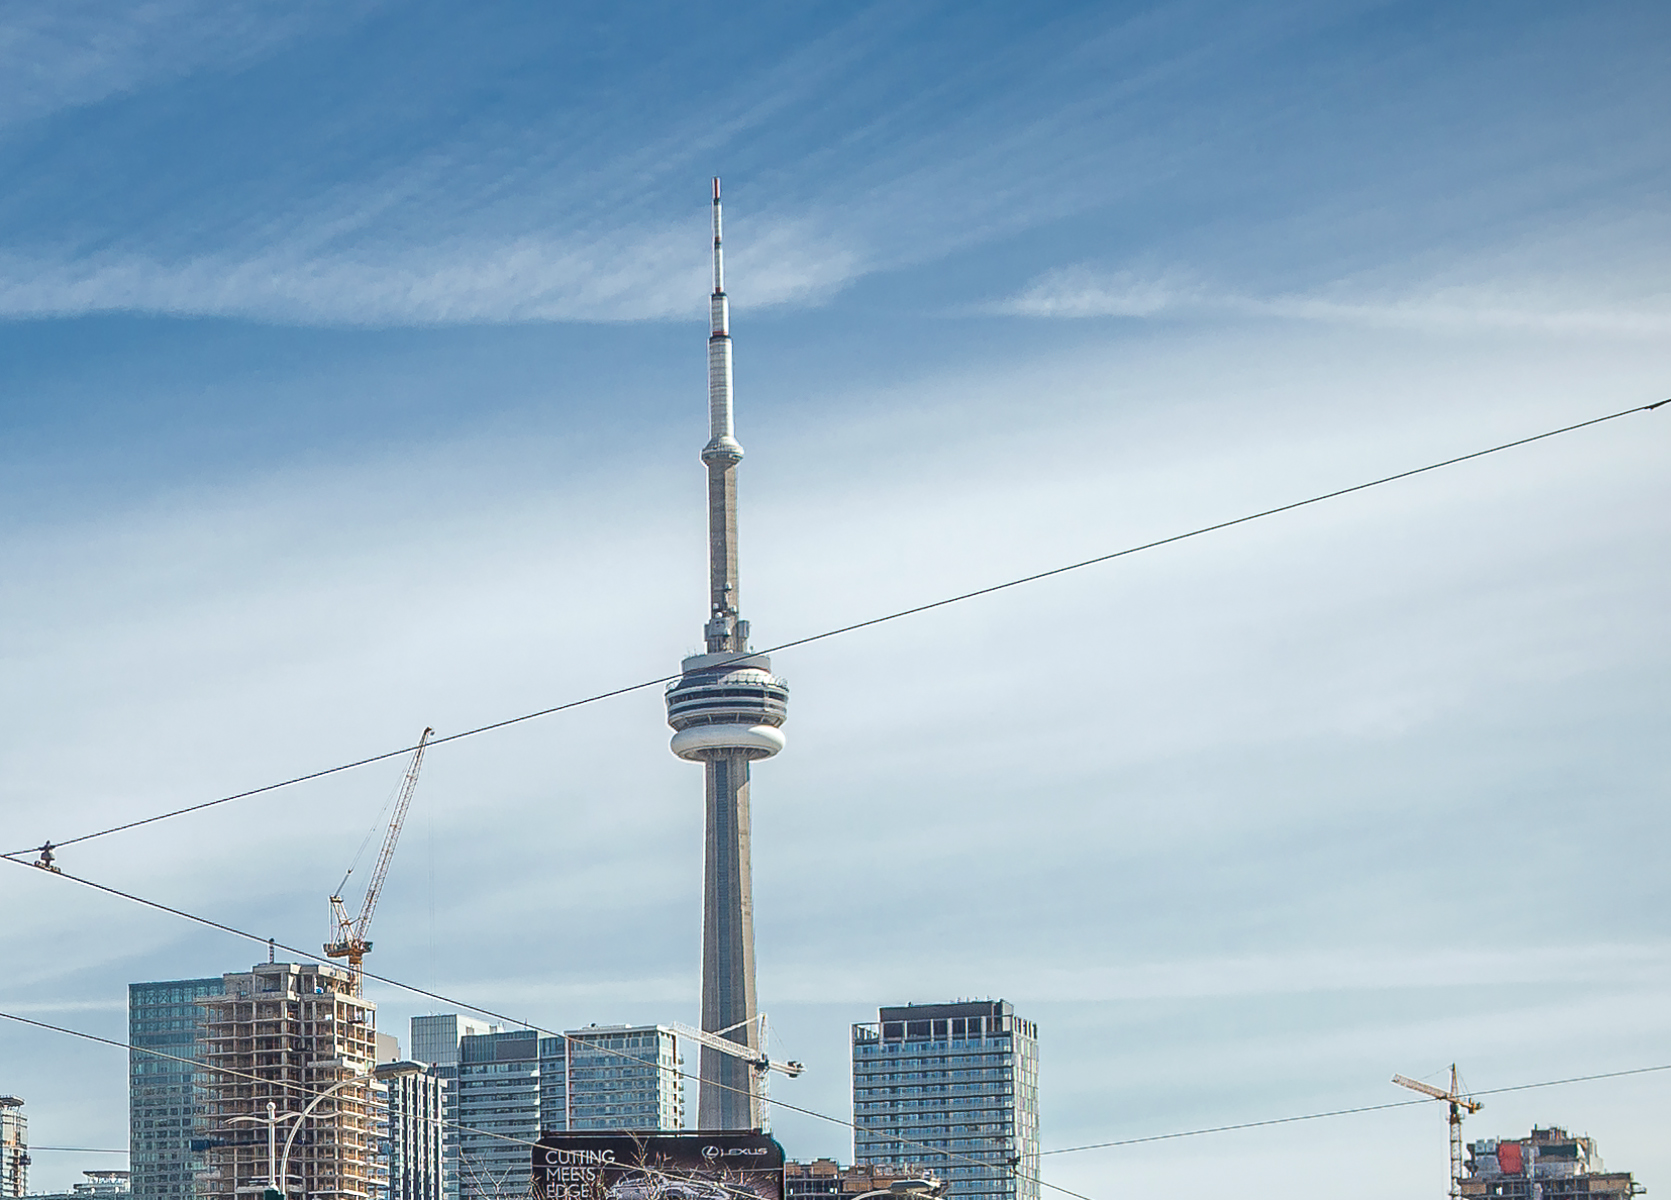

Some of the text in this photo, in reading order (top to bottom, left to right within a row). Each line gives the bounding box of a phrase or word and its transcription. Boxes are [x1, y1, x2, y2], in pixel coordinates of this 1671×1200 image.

[545, 1149, 616, 1165] CUTTING
[721, 1147, 768, 1156] LEXUS
[546, 1167, 596, 1182] MEETS
